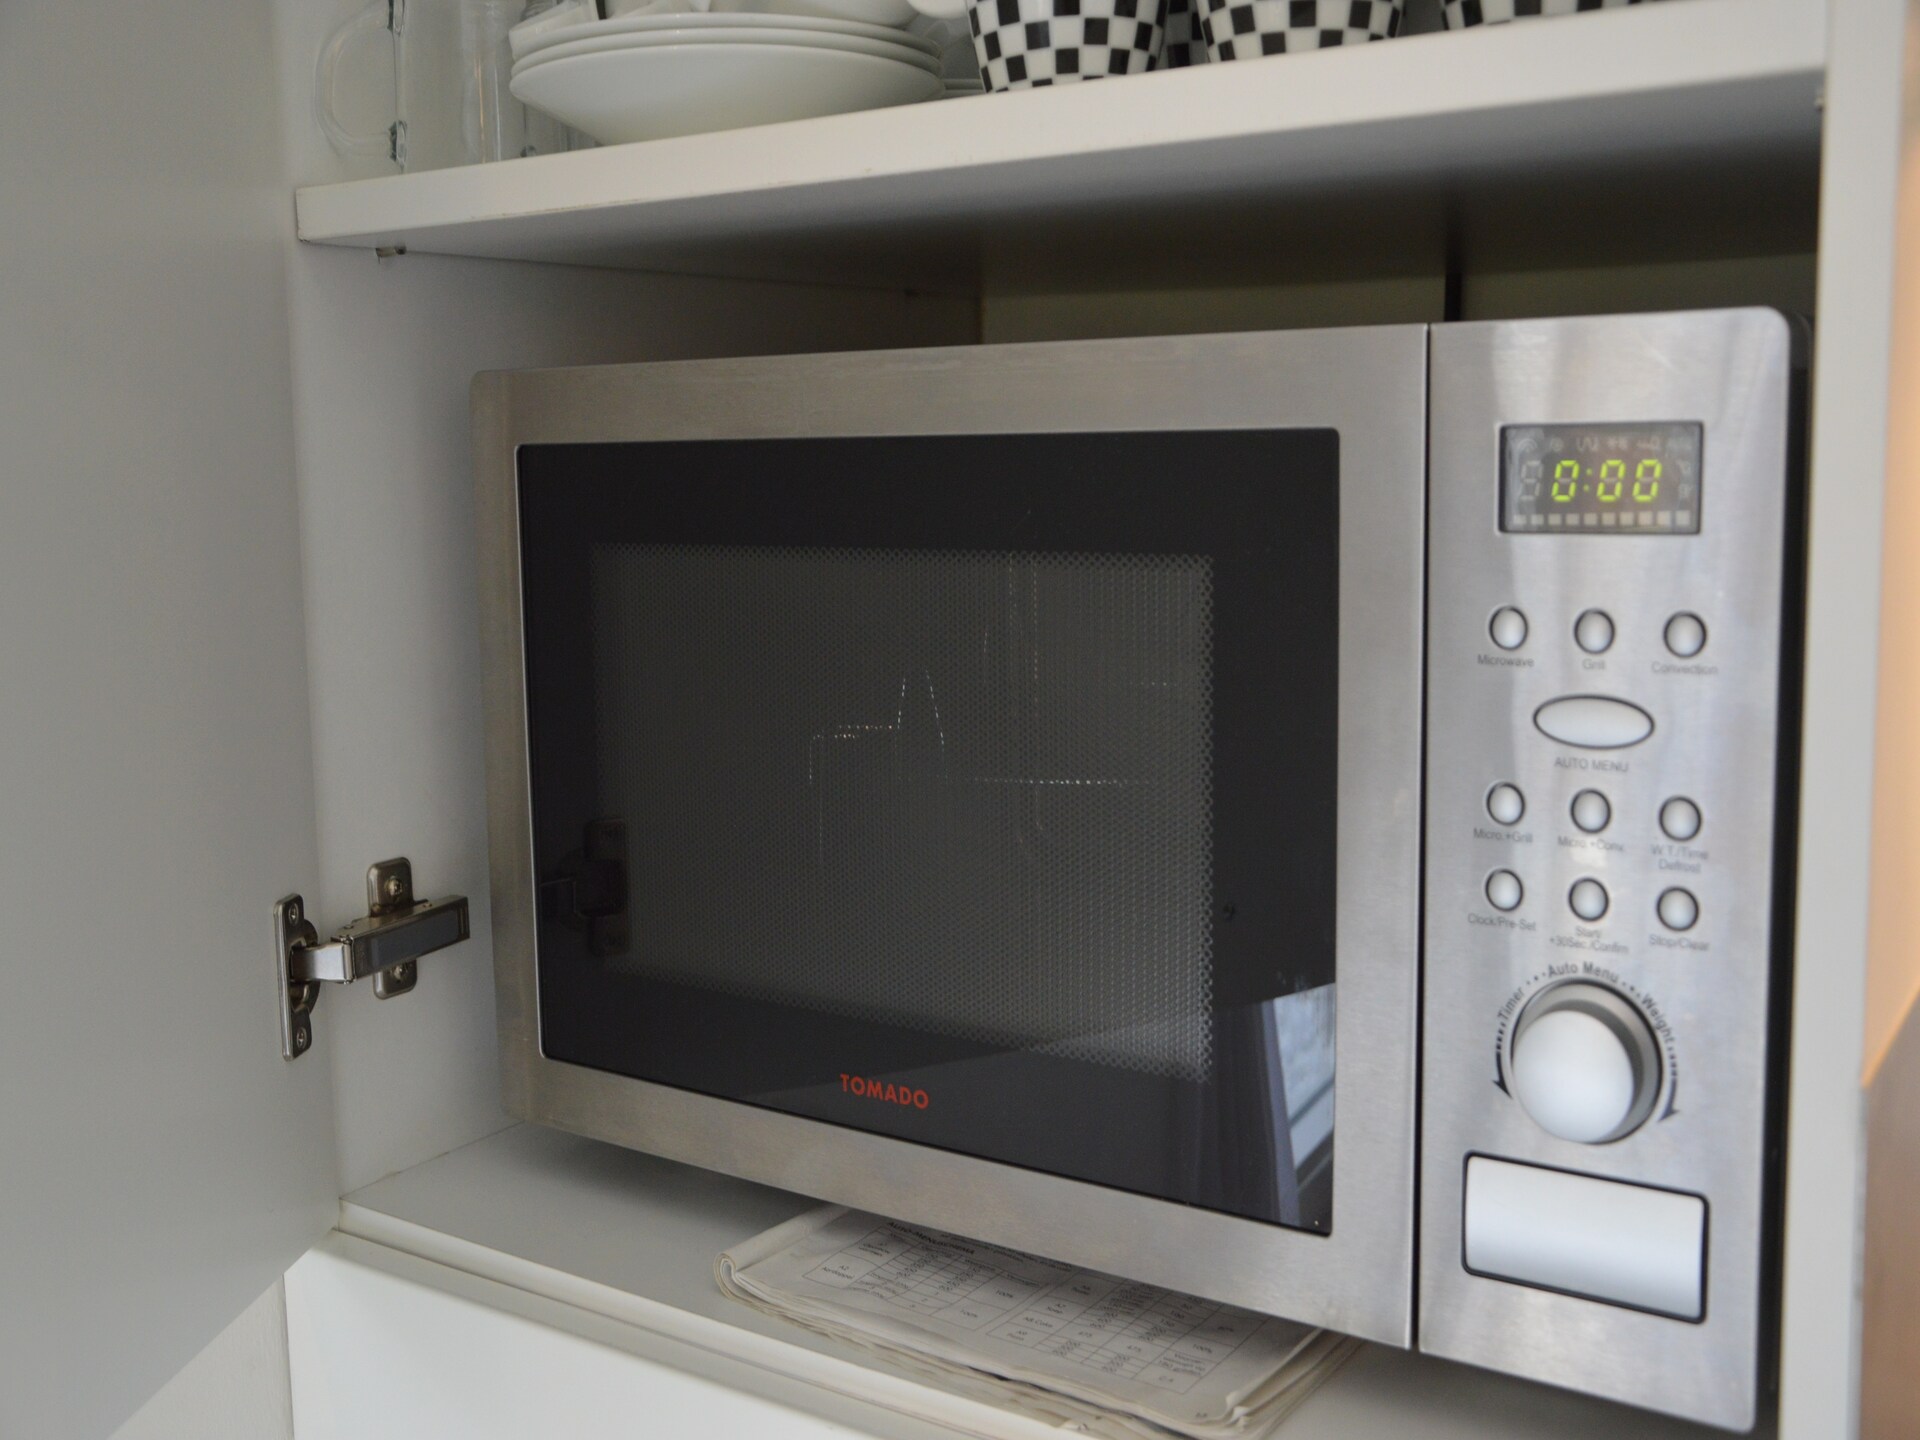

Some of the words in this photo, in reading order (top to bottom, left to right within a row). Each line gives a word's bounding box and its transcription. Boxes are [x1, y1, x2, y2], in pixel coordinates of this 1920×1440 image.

[1552, 459, 1662, 502] 0:00
[1477, 654, 1535, 668] Microwave
[1582, 659, 1606, 671] Grill
[1651, 662, 1718, 676] Convection
[1554, 757, 1589, 770] AUTO
[1591, 759, 1630, 773] MENU
[1548, 962, 1579, 979] Auto
[1583, 961, 1620, 984] Menu
[1497, 987, 1526, 1020] Timer
[1641, 994, 1676, 1044] Weight
[840, 1072, 929, 1110] TOMADO
